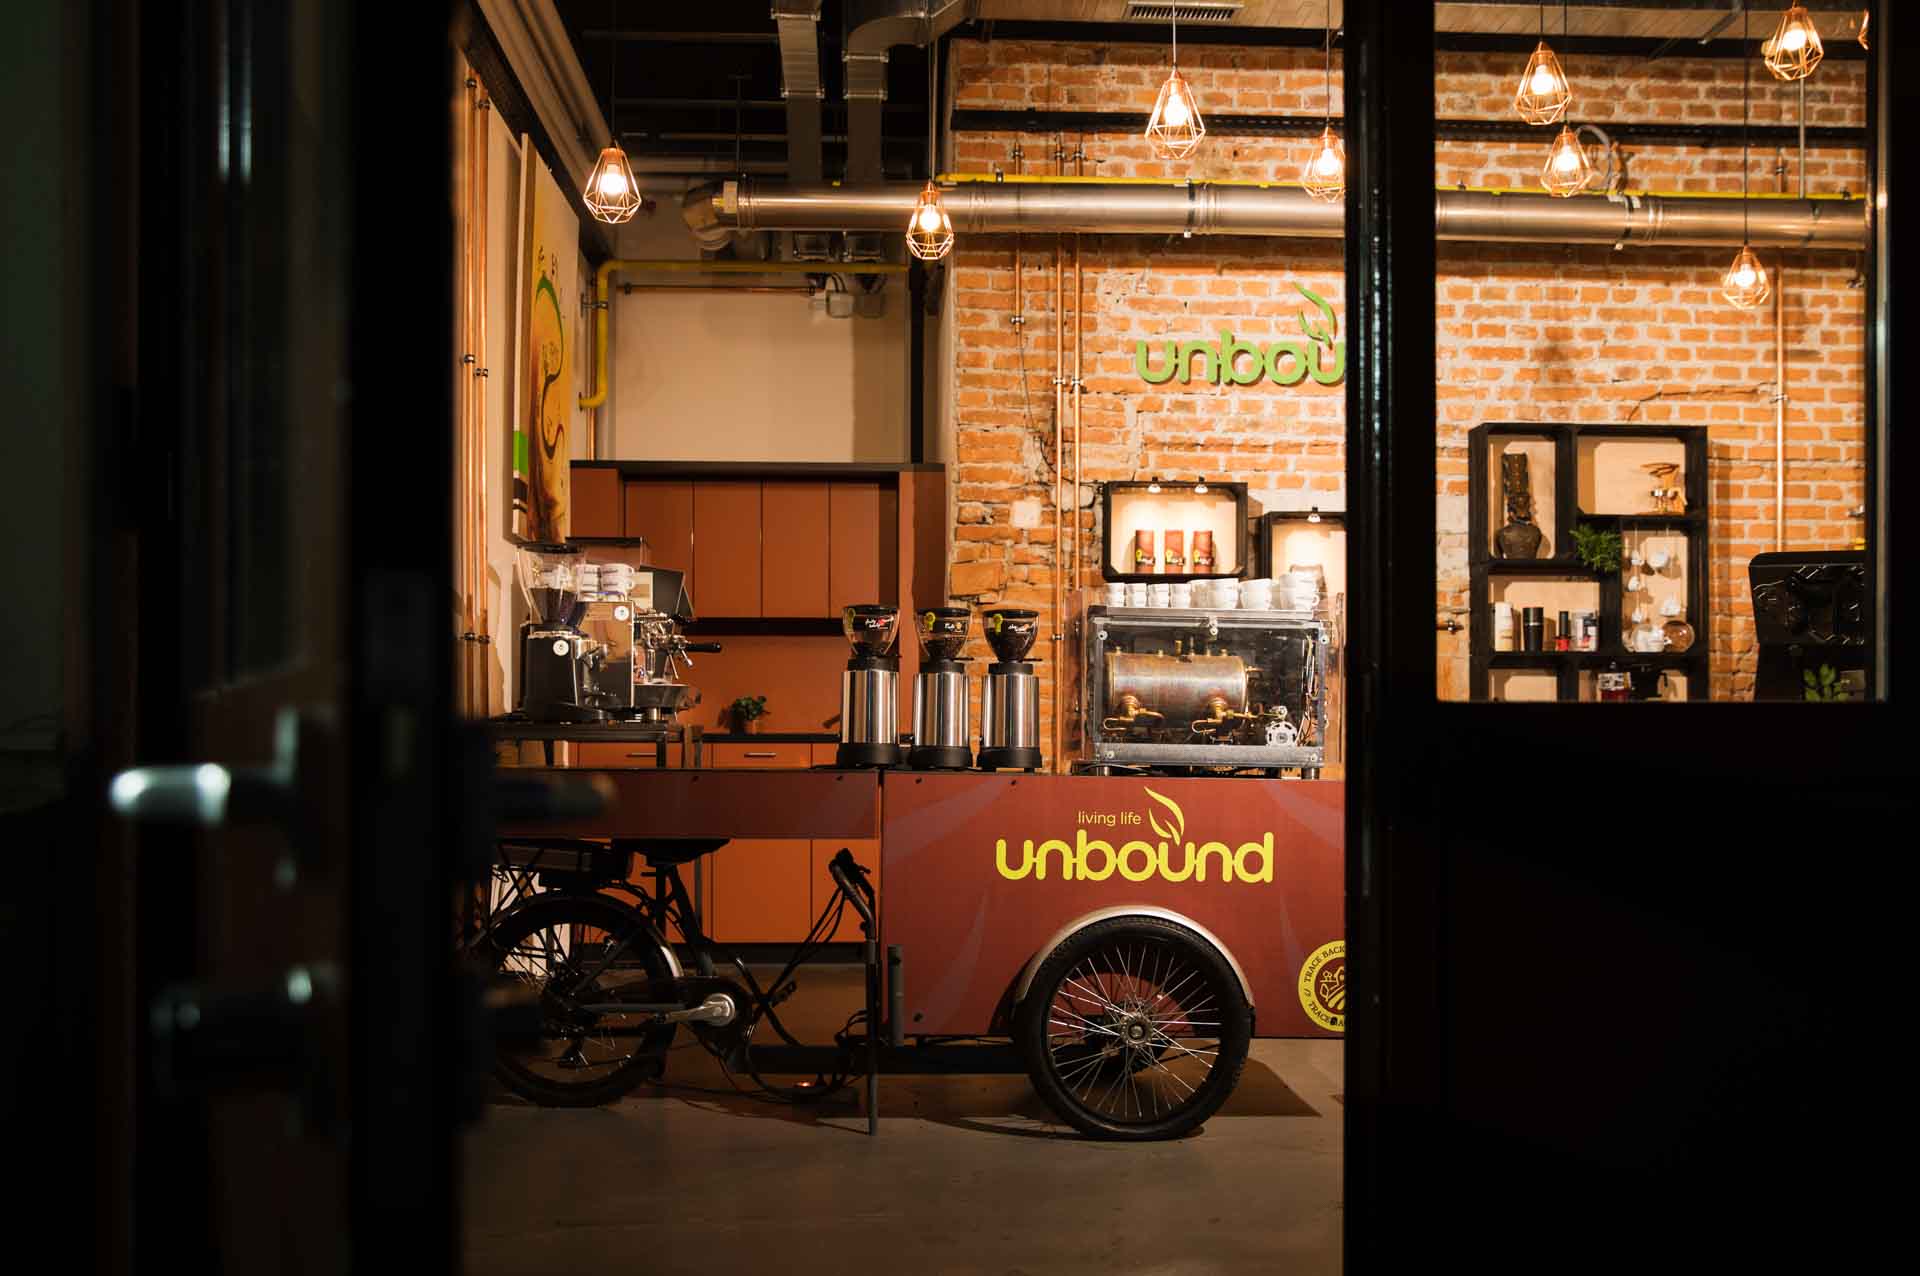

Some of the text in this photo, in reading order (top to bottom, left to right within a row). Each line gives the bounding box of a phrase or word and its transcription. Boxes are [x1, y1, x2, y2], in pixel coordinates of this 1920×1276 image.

[1078, 811, 1142, 827] living life
[995, 829, 1274, 883] unbound
[1304, 955, 1322, 982] TRACE
